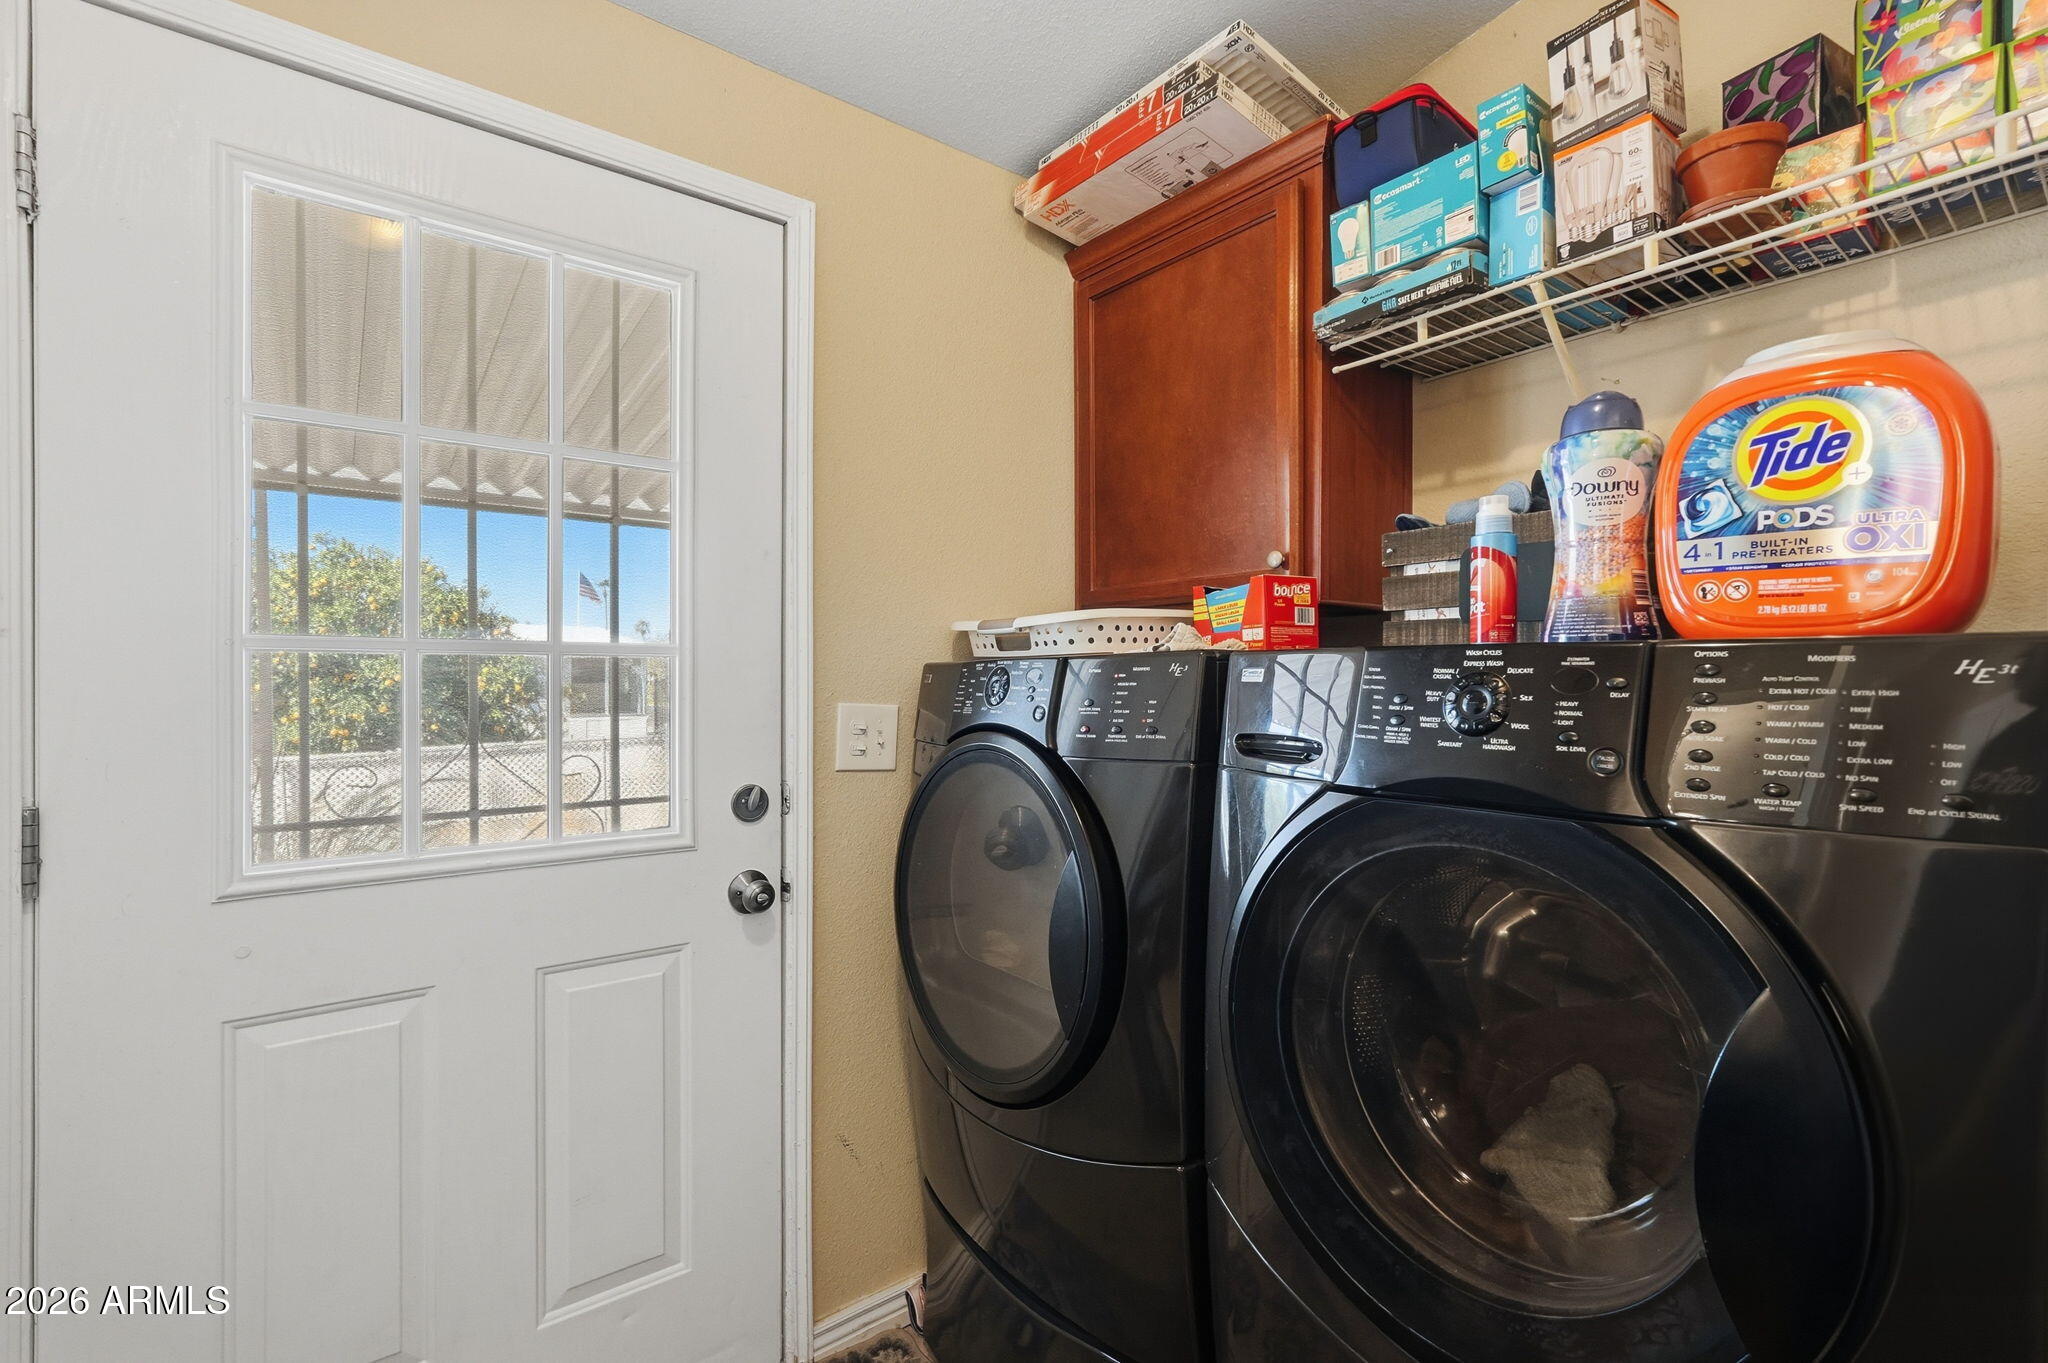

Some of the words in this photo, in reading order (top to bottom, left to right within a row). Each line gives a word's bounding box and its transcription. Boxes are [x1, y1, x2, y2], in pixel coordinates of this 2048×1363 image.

[1894, 10, 1946, 39] Kleenex
[1146, 91, 1157, 113] 7
[1183, 91, 1215, 115] 20x20x1
[1164, 102, 1176, 126] 7
[1506, 104, 1520, 114] LED
[1455, 154, 1472, 168] LED
[1381, 176, 1422, 200] ecosmart
[1040, 198, 1077, 222] HDX
[1398, 296, 1410, 306] SAFE
[1411, 289, 1424, 300] HEAT
[1426, 280, 1449, 295] CHAFING
[1449, 272, 1463, 288] FUEL
[1747, 419, 1852, 489] Tide
[1571, 480, 1639, 496] Downy
[1757, 505, 1836, 530] PODS
[1856, 507, 1926, 524] ULTRA
[1750, 537, 1808, 549] BUILT-IN
[1845, 523, 1928, 552] OXI
[1683, 543, 1700, 561] 4
[1714, 541, 1723, 560] 1
[1732, 545, 1834, 560] PRE-TREATERS
[1273, 582, 1310, 597] bounce
[1807, 654, 1857, 663] MODIFIERS
[1851, 689, 1876, 697] EXTRA
[1798, 721, 1825, 729] WARM
[1849, 723, 1884, 731] MEDIUM
[1765, 737, 1791, 745] WARM
[1796, 738, 1818, 746] COLD
[1763, 754, 1784, 762] COLD
[1847, 757, 1872, 765] EXTRA
[1942, 761, 1963, 769] LOW
[1778, 770, 1798, 778] COLD
[1804, 771, 1826, 779] COLD
[1860, 775, 1879, 783] SPIN
[1674, 792, 1709, 800] EXTENDED
[1709, 793, 1726, 801] SPIN
[1754, 798, 1781, 806] WATER
[1782, 799, 1802, 807] TEMP
[1838, 804, 1857, 812] SPIN
[1859, 805, 1885, 814] SPEED
[1908, 808, 1925, 816] END
[1939, 809, 1966, 819] CYCLE
[1967, 811, 2001, 821] SIGNAL
